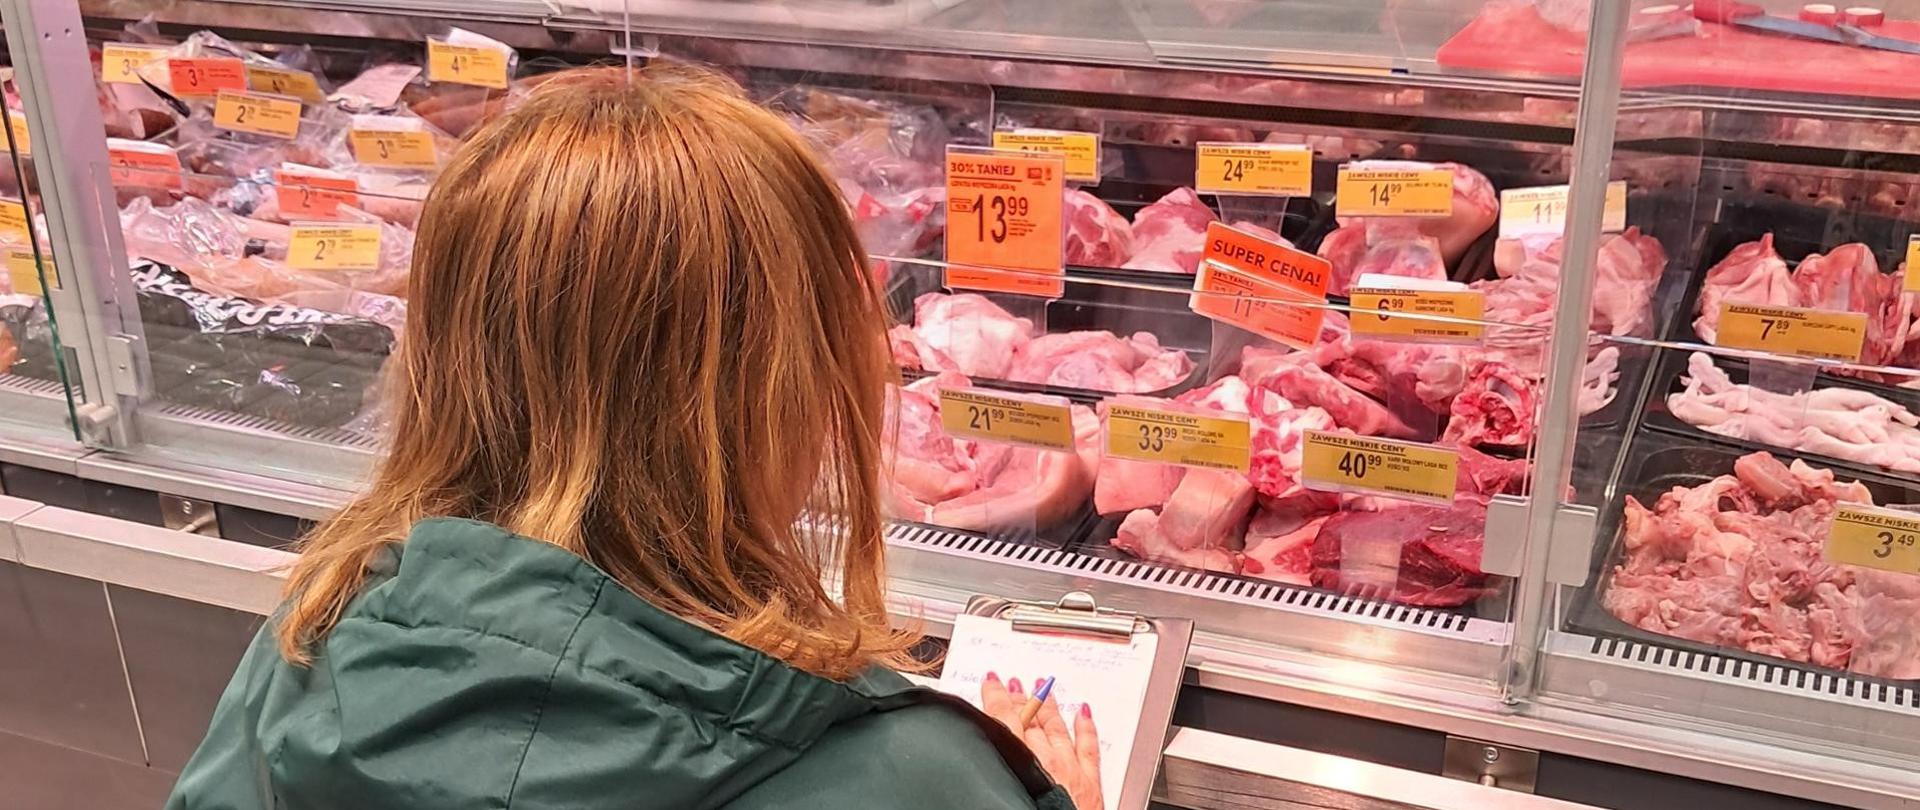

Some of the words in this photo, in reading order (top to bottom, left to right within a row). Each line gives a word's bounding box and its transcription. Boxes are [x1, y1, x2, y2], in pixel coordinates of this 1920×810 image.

[950, 162, 975, 174] 30%
[976, 163, 1016, 176] TANIEJ
[1212, 239, 1266, 268] SUPER
[1270, 259, 1322, 287] CENA!
[1111, 408, 1146, 418] ZAWSZE
[1147, 412, 1174, 422] NISKIE
[1176, 416, 1198, 425] CENY
[1311, 434, 1349, 446] ZAWSZE
[1350, 440, 1380, 450] NISKIE
[1381, 444, 1406, 453] CENY
[1838, 511, 1882, 524] ZAWSZE
[1884, 518, 1920, 530] NISKIE
